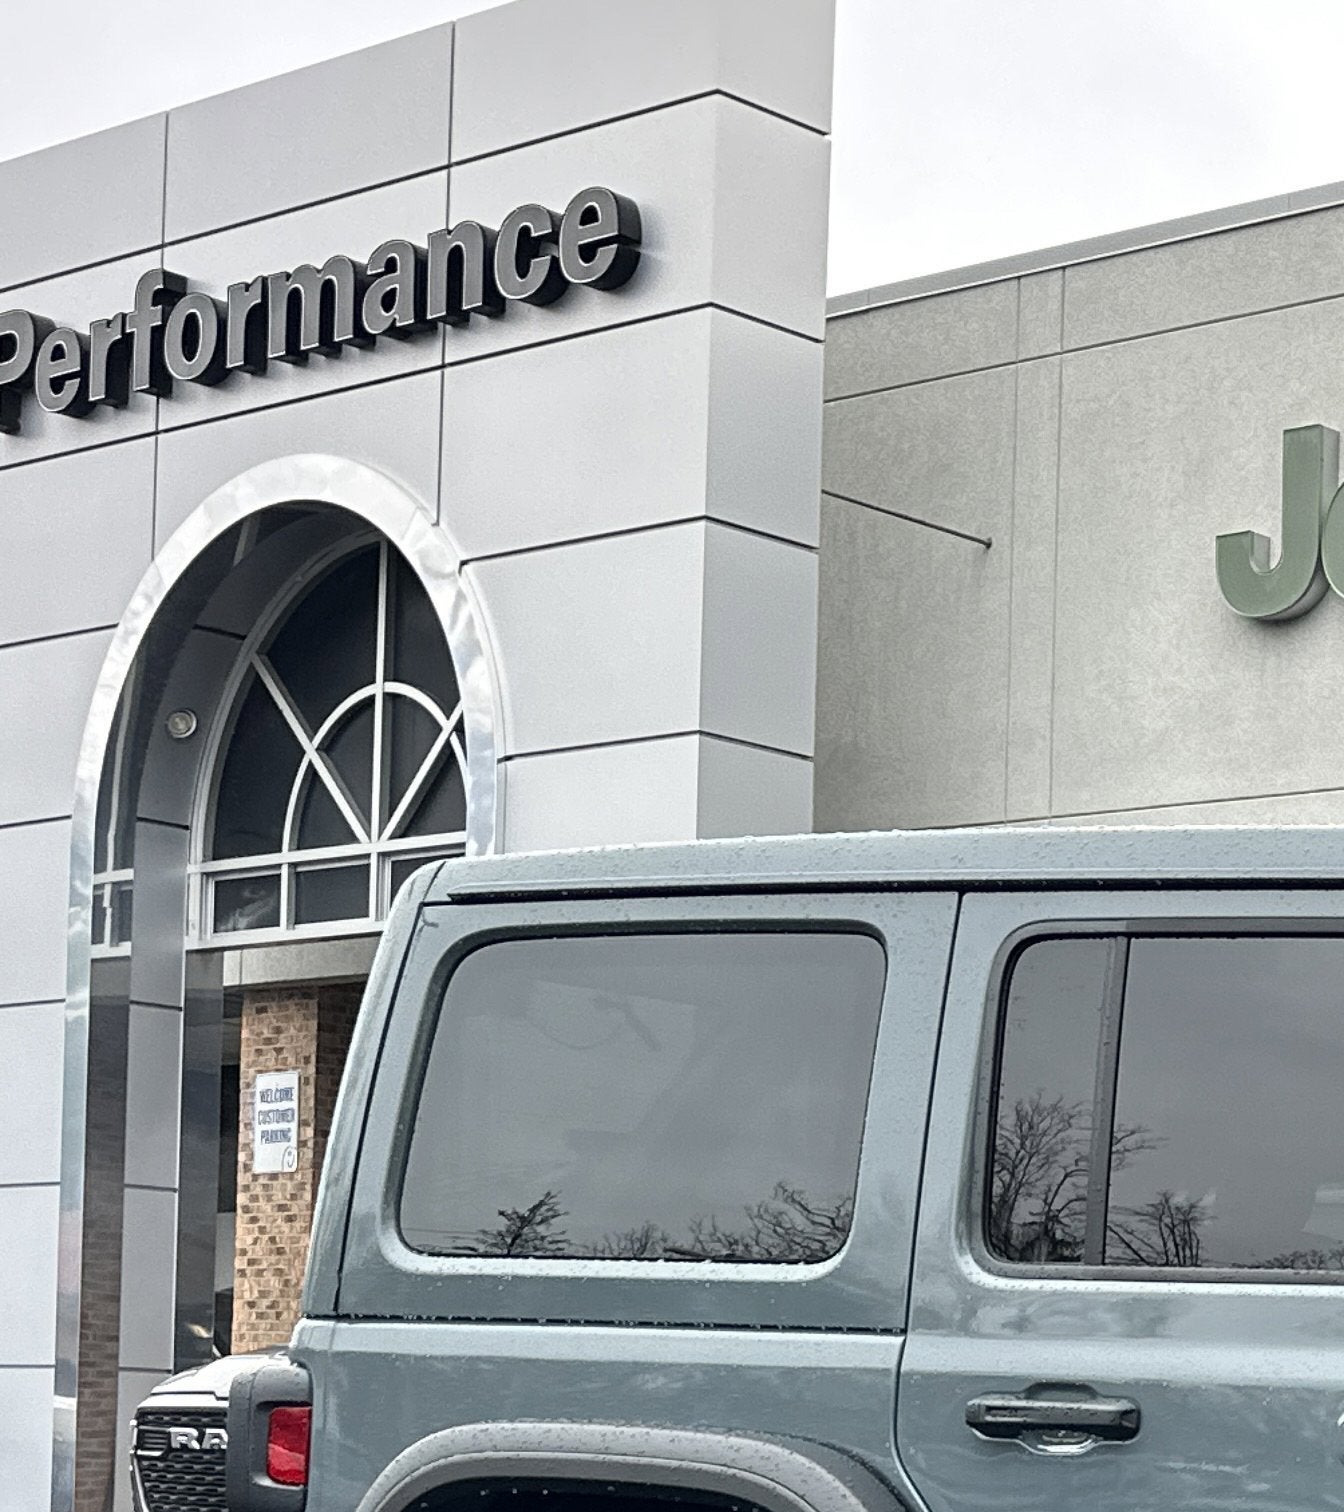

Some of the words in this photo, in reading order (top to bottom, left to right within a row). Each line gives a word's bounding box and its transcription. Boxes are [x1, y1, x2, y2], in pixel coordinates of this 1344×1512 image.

[0, 186, 642, 432] Performance
[260, 1087, 294, 1103] WELCOME
[258, 1108, 295, 1125] CUSTOMER
[260, 1127, 292, 1145] PARKING
[169, 1427, 229, 1450] RA
